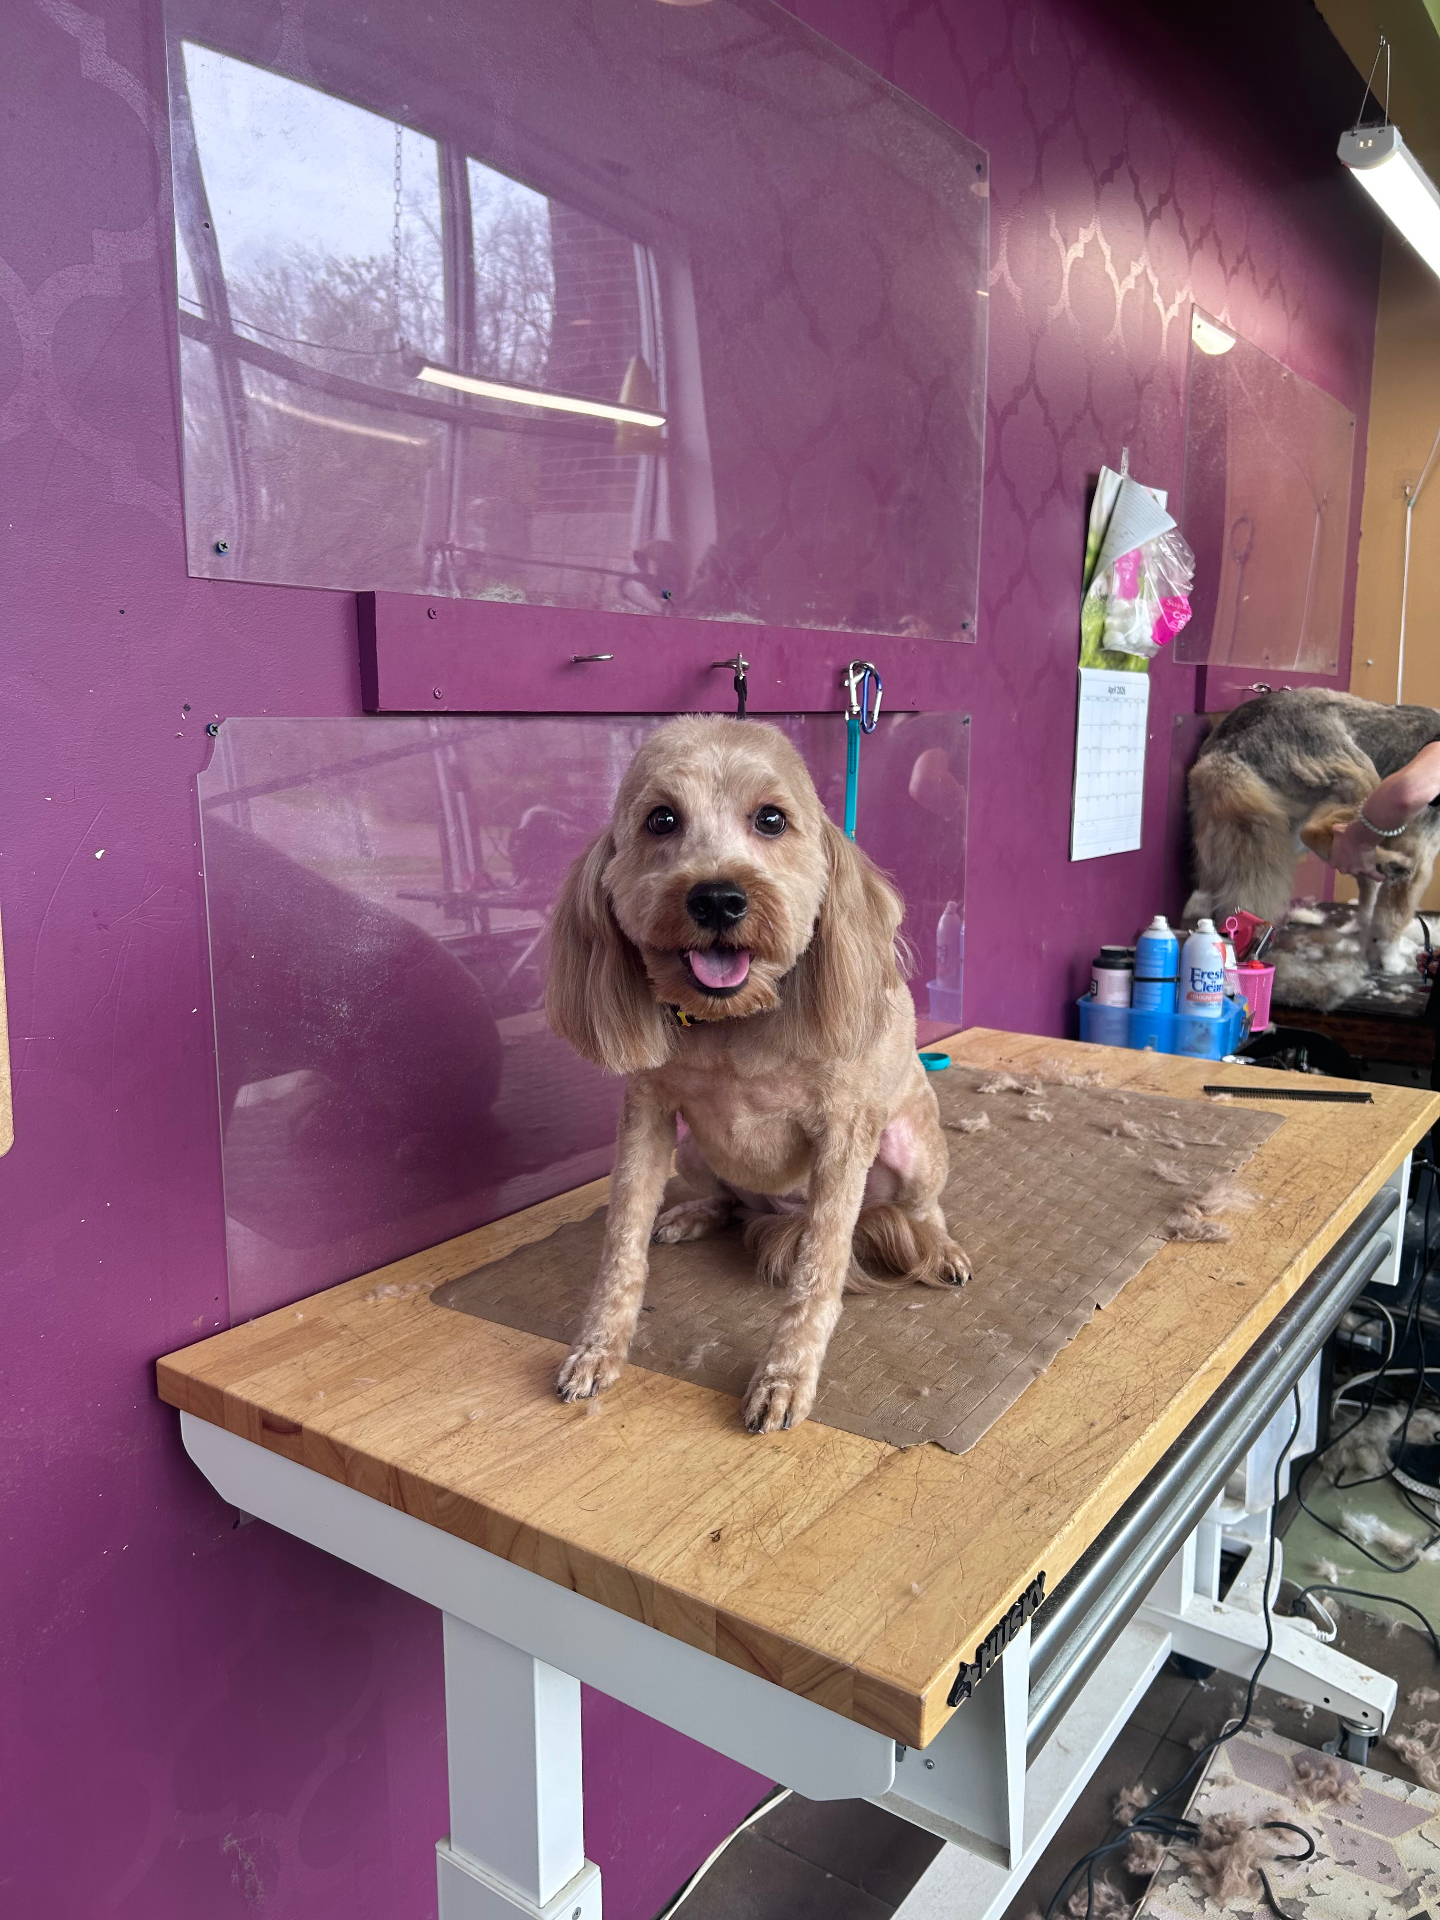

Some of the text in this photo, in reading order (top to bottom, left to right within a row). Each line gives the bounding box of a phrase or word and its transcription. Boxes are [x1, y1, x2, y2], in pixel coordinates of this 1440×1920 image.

[1190, 967, 1224, 982] Fresh
[1191, 980, 1223, 993] Clean
[976, 1571, 1046, 1679] HUSKY
